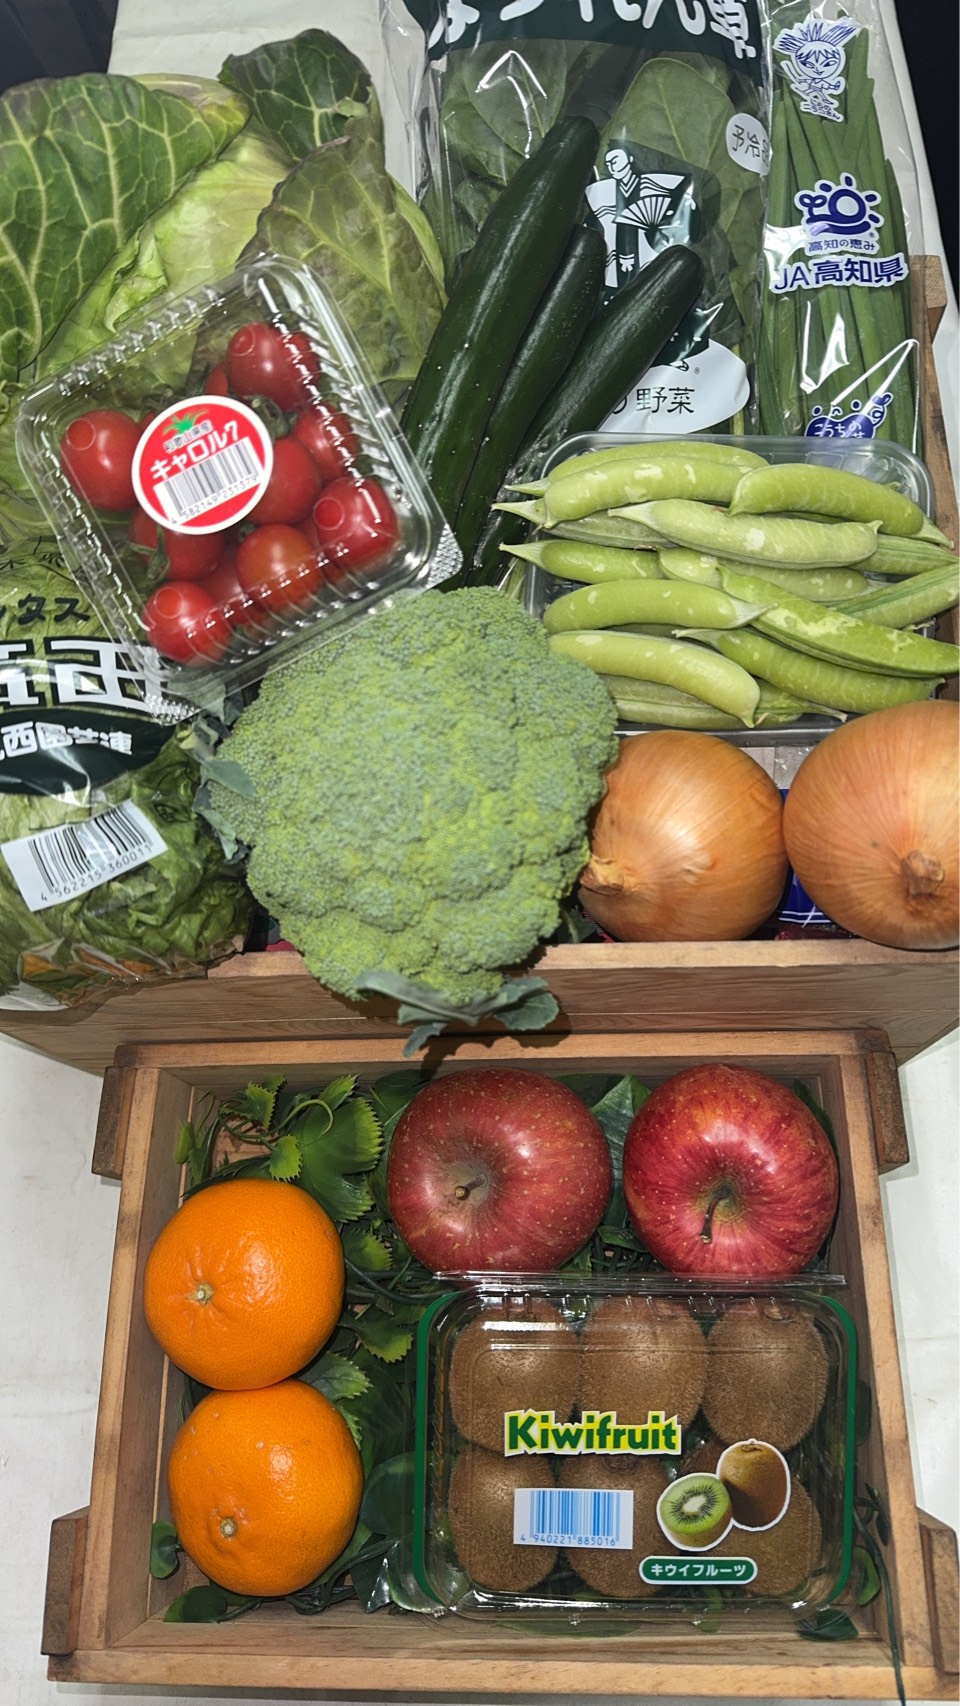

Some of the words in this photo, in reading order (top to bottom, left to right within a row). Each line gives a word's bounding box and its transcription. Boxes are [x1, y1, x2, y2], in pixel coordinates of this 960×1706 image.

[808, 239, 876, 252] 高知の恵み
[774, 257, 904, 290] JA高知県
[55, 871, 102, 898] 562215
[107, 845, 152, 872] 360011
[509, 1415, 676, 1449] Kiwifruit
[534, 1534, 572, 1545] 940221
[578, 1536, 616, 1546] 885016
[651, 1564, 746, 1577] キウイフルーツ
